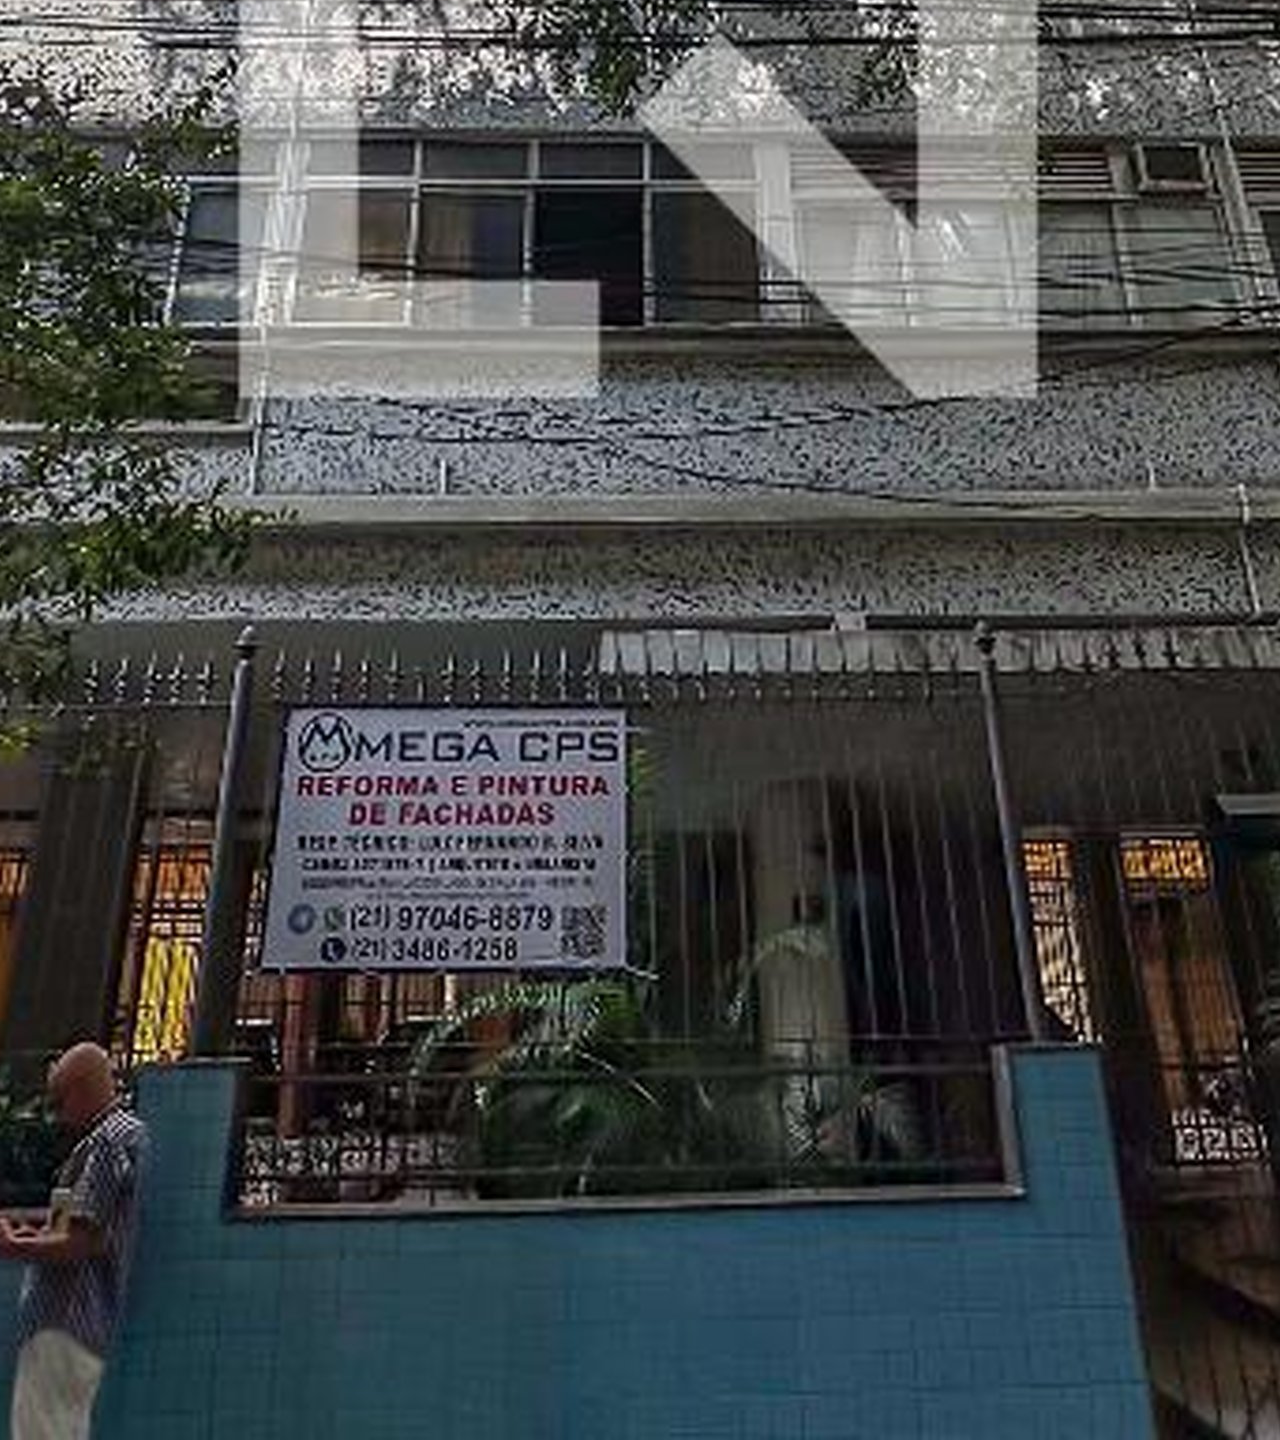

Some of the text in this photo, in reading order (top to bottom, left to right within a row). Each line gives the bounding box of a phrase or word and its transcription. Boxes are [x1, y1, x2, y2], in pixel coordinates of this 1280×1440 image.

[354, 731, 500, 762] MEGA
[519, 731, 619, 762] CPS
[297, 775, 610, 796] REFORMA E PINTURA
[349, 803, 555, 826] DE FACHADAS
[397, 905, 553, 931] 97046-8879
[391, 936, 518, 960] 3486-1258
